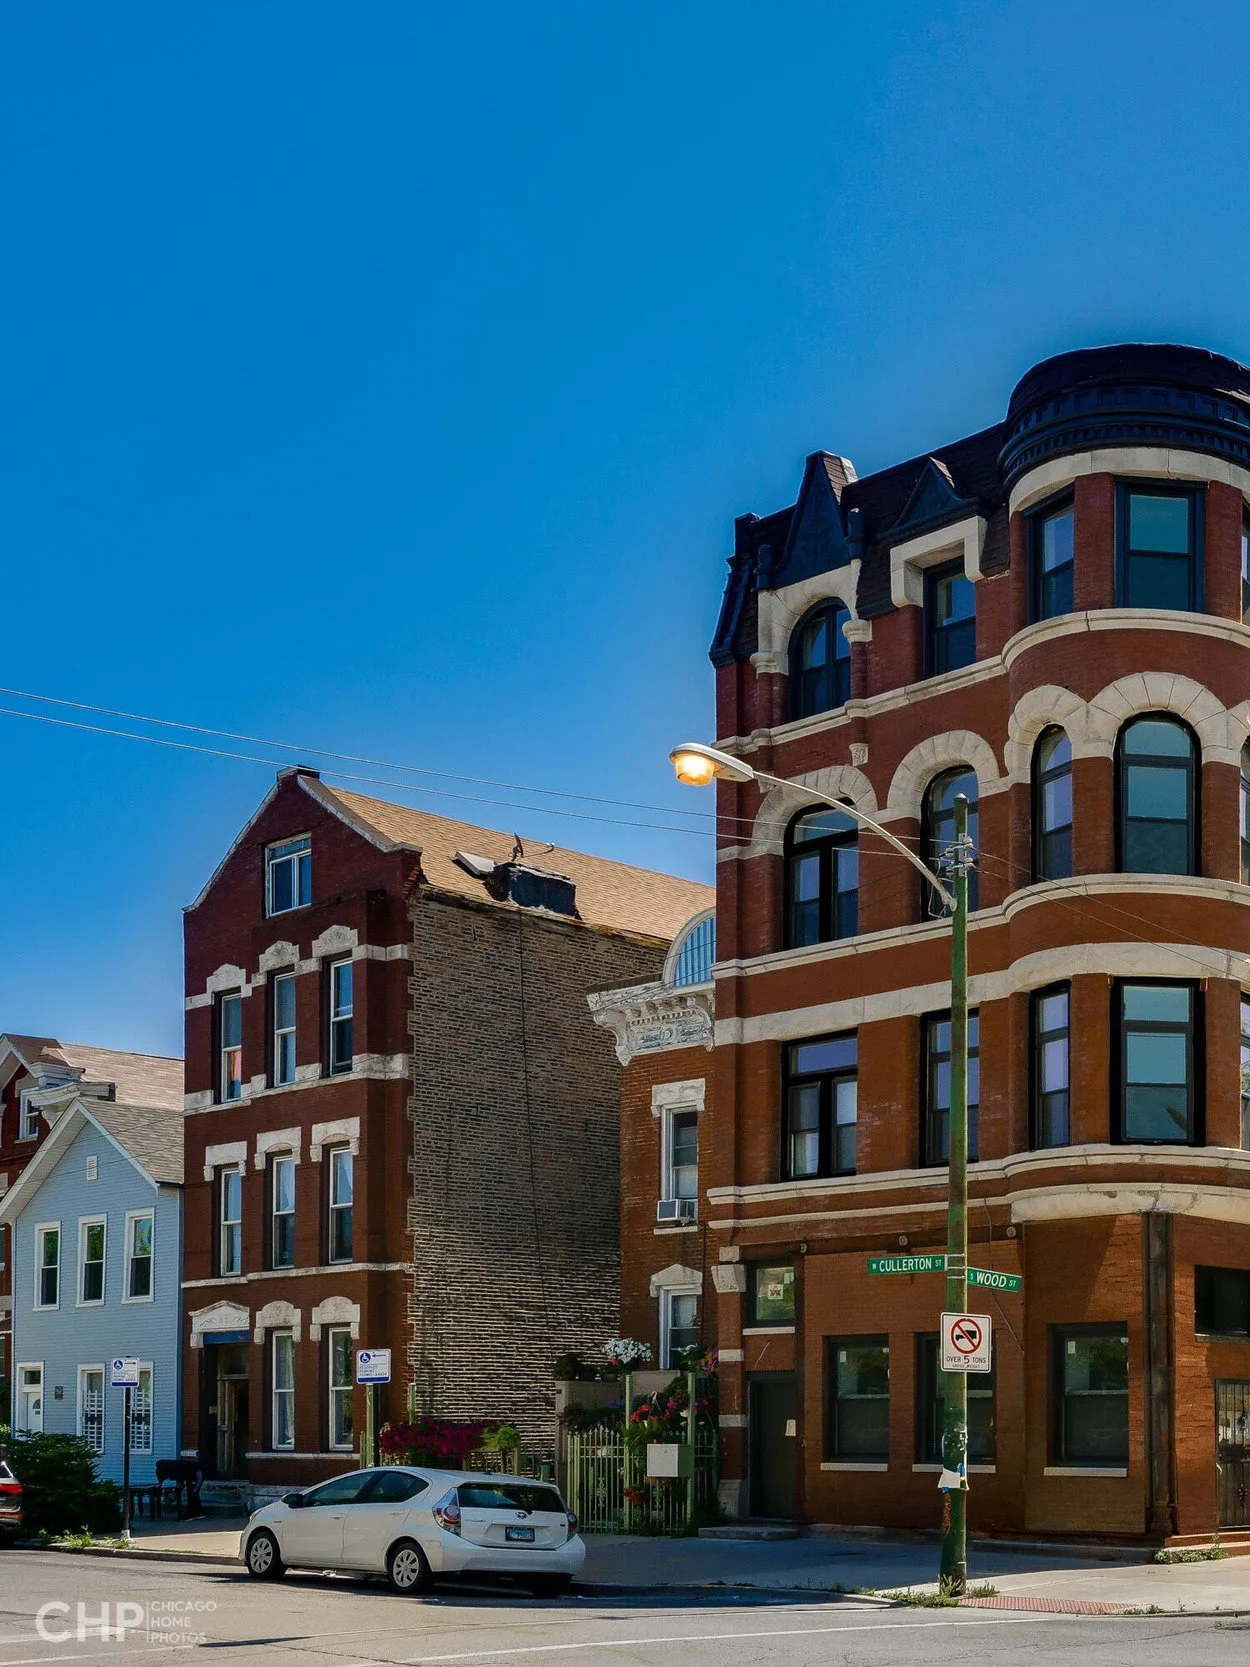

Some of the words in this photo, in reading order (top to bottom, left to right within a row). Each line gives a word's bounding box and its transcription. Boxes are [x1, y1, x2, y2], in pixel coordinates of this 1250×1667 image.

[879, 1257, 932, 1273] CULLERTON
[935, 1259, 942, 1267] ST
[976, 1271, 1007, 1288] WOOD
[963, 1355, 970, 1364] 5
